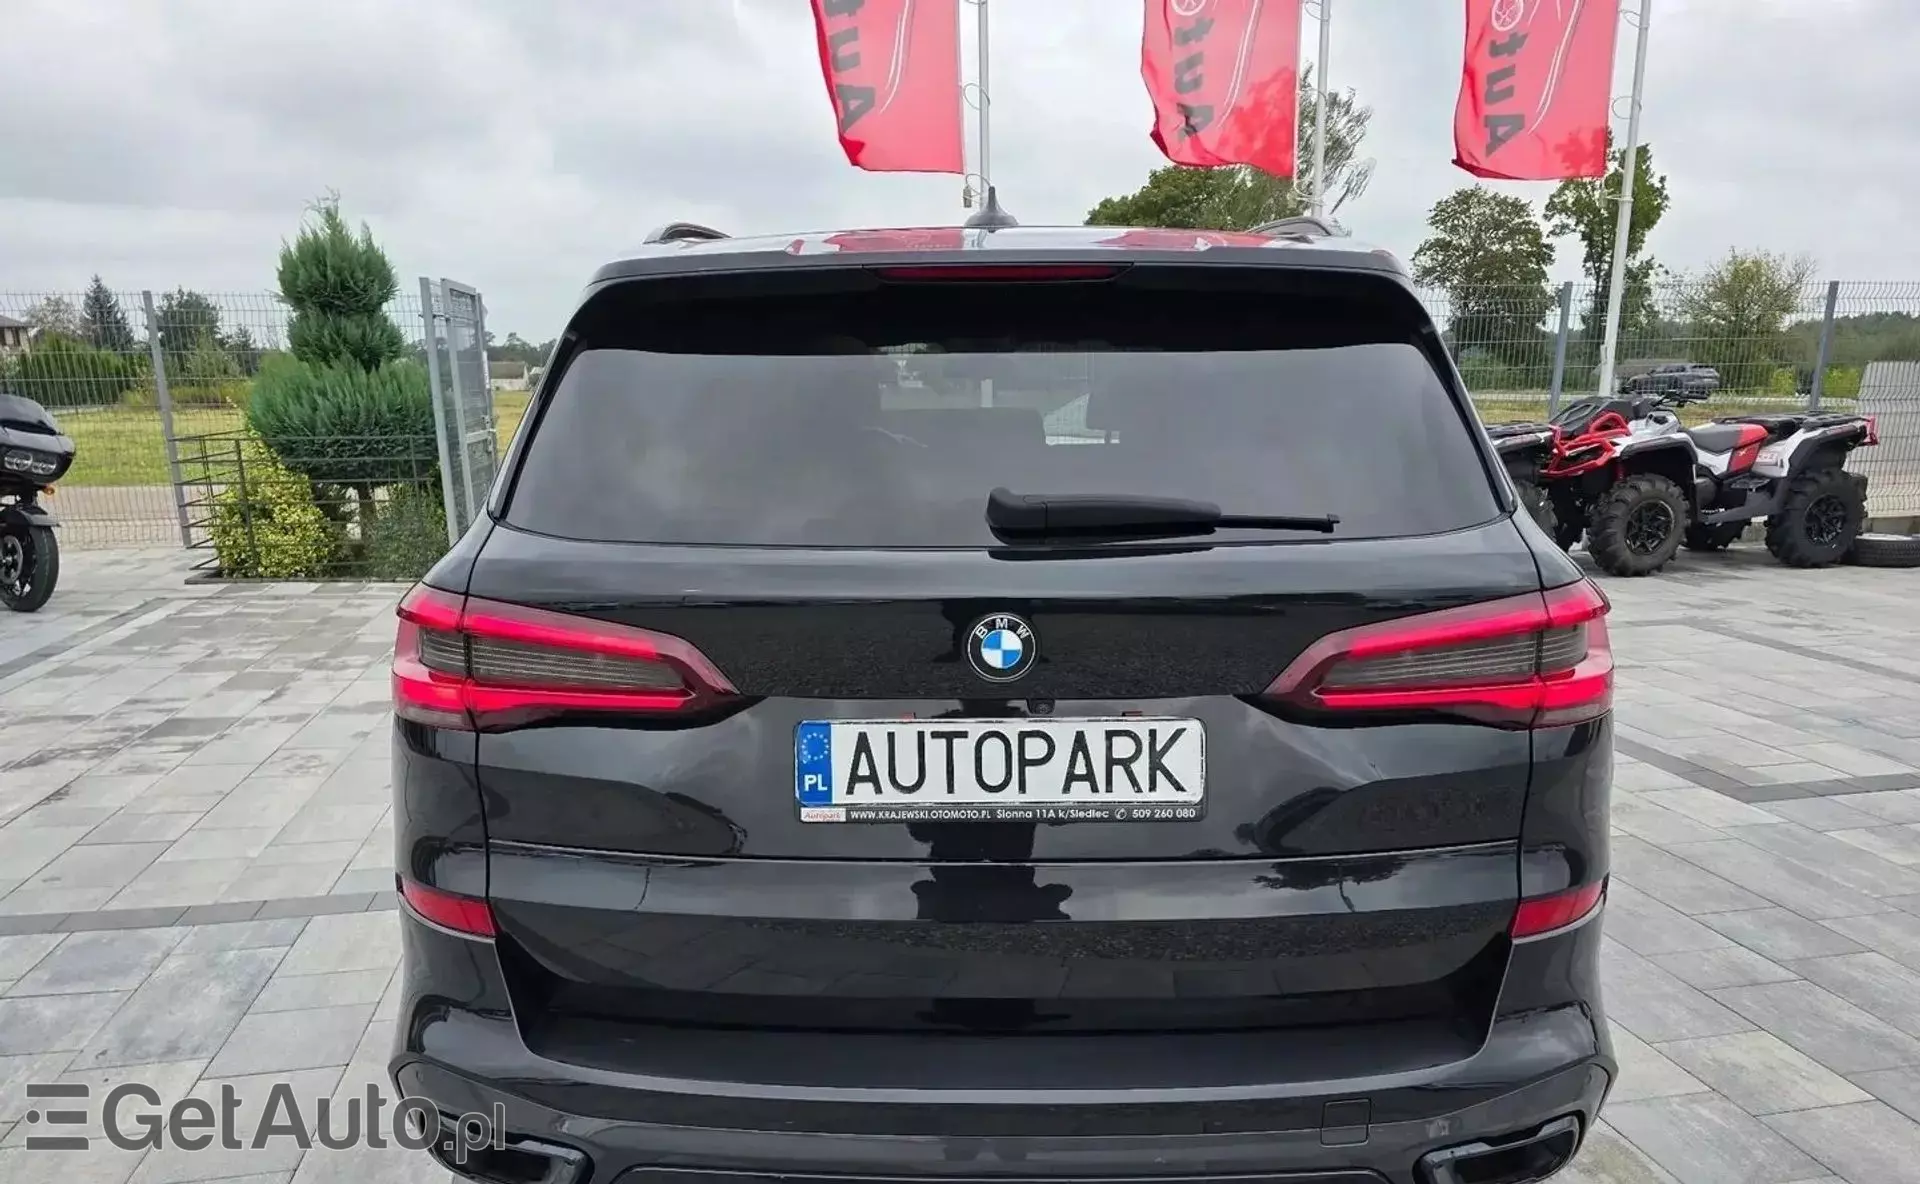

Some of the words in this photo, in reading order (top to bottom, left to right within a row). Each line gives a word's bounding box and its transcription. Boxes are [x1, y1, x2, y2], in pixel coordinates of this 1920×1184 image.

[975, 618, 1029, 639] BMW
[845, 727, 1188, 795] AUTOPARK
[804, 775, 828, 792] PL
[850, 809, 992, 820] WWW.KRAJEWSKI.OTOMOTO.PL
[1035, 808, 1056, 819] 11A
[1131, 808, 1152, 819] 509
[1153, 808, 1173, 819] 260
[1175, 808, 1196, 819] 080
